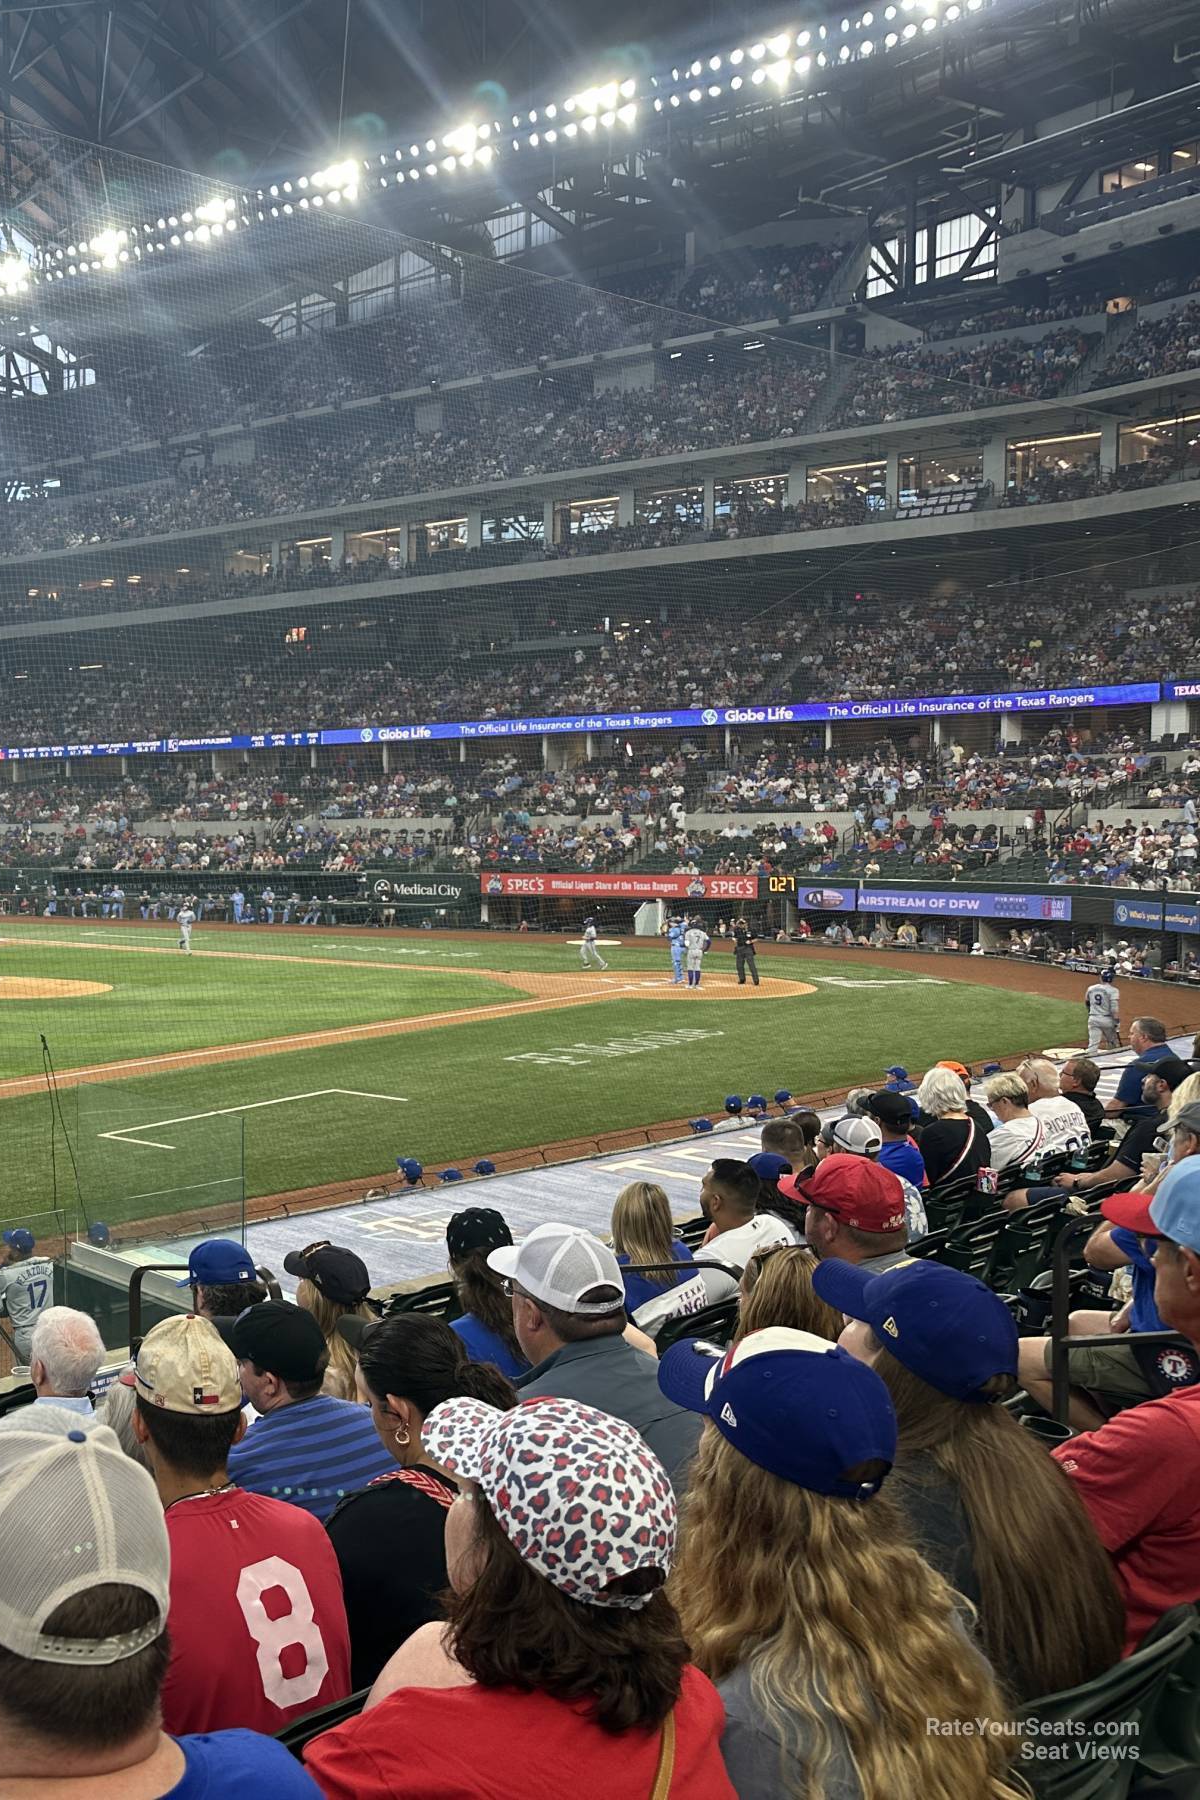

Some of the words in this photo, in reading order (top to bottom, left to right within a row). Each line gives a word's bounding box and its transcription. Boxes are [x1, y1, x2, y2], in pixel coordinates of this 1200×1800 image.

[828, 706, 848, 716] The
[852, 703, 891, 715] Official
[894, 702, 915, 714] Life
[919, 700, 974, 712] Insurance
[978, 698, 991, 709] of
[993, 697, 1012, 708] the
[1015, 695, 1046, 707] Texas
[1049, 692, 1095, 707] Rangers
[725, 709, 766, 722] Globe
[768, 707, 793, 720] Life
[459, 725, 476, 735] The
[478, 723, 509, 734] Official
[511, 722, 527, 733] Life
[529, 720, 572, 731] Insurance
[574, 719, 585, 729] of
[587, 718, 602, 728] the
[604, 717, 631, 727] Texas
[633, 715, 672, 727] Rangers
[378, 729, 409, 740] Globe
[411, 727, 431, 738] Life
[179, 739, 200, 747] ADAM
[393, 883, 437, 895] Medical
[438, 884, 462, 899] City
[507, 876, 545, 891] SPEC'S
[551, 880, 574, 889] Official
[575, 880, 594, 891] Liquor
[595, 881, 612, 890] Store
[613, 881, 619, 890] of
[621, 882, 632, 891] the
[633, 882, 650, 891] Texas
[652, 882, 678, 893] Rangers
[711, 879, 754, 894] SPEC'S
[769, 876, 795, 892] 027
[858, 895, 926, 908] AIRSTREAM
[929, 898, 945, 909] OF
[949, 899, 980, 910] DFW
[1094, 993, 1103, 1006] 9
[26, 1279, 47, 1310] 17
[236, 1555, 329, 1710] 8
